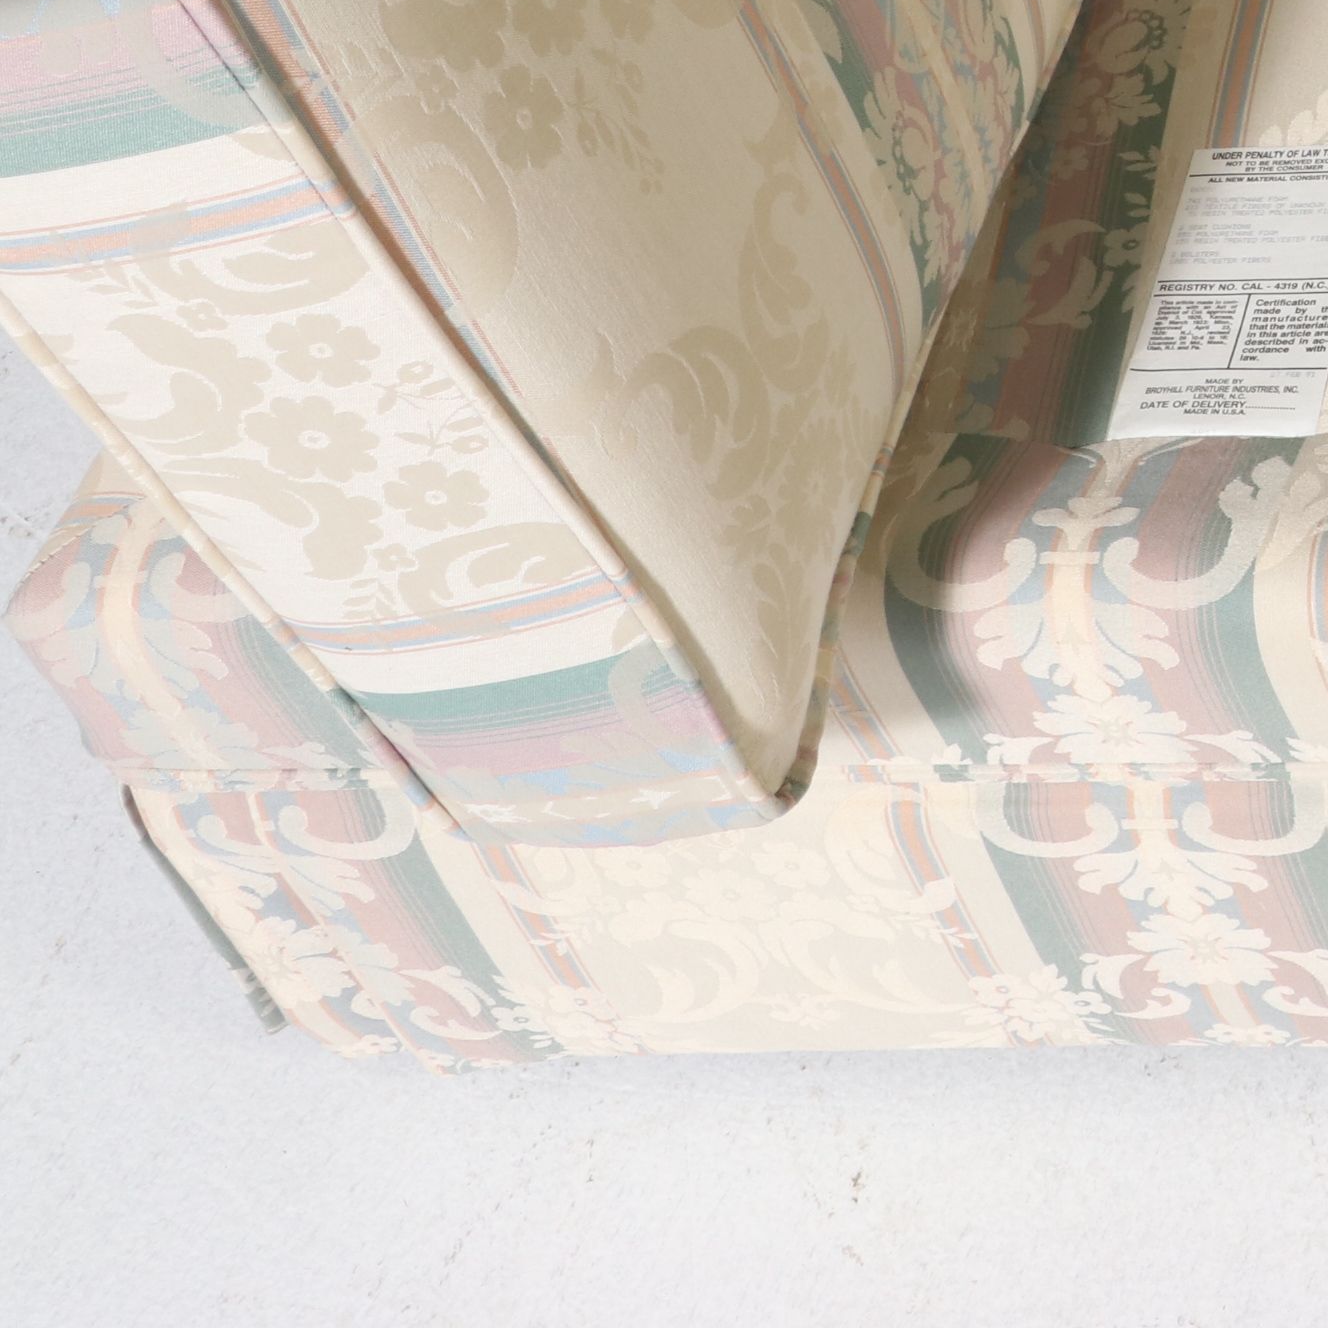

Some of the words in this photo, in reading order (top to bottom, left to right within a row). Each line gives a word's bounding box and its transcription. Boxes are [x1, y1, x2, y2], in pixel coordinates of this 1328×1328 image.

[1212, 152, 1242, 160] UNDER
[1245, 151, 1284, 159] PENALTY
[1296, 307, 1307, 315] by
